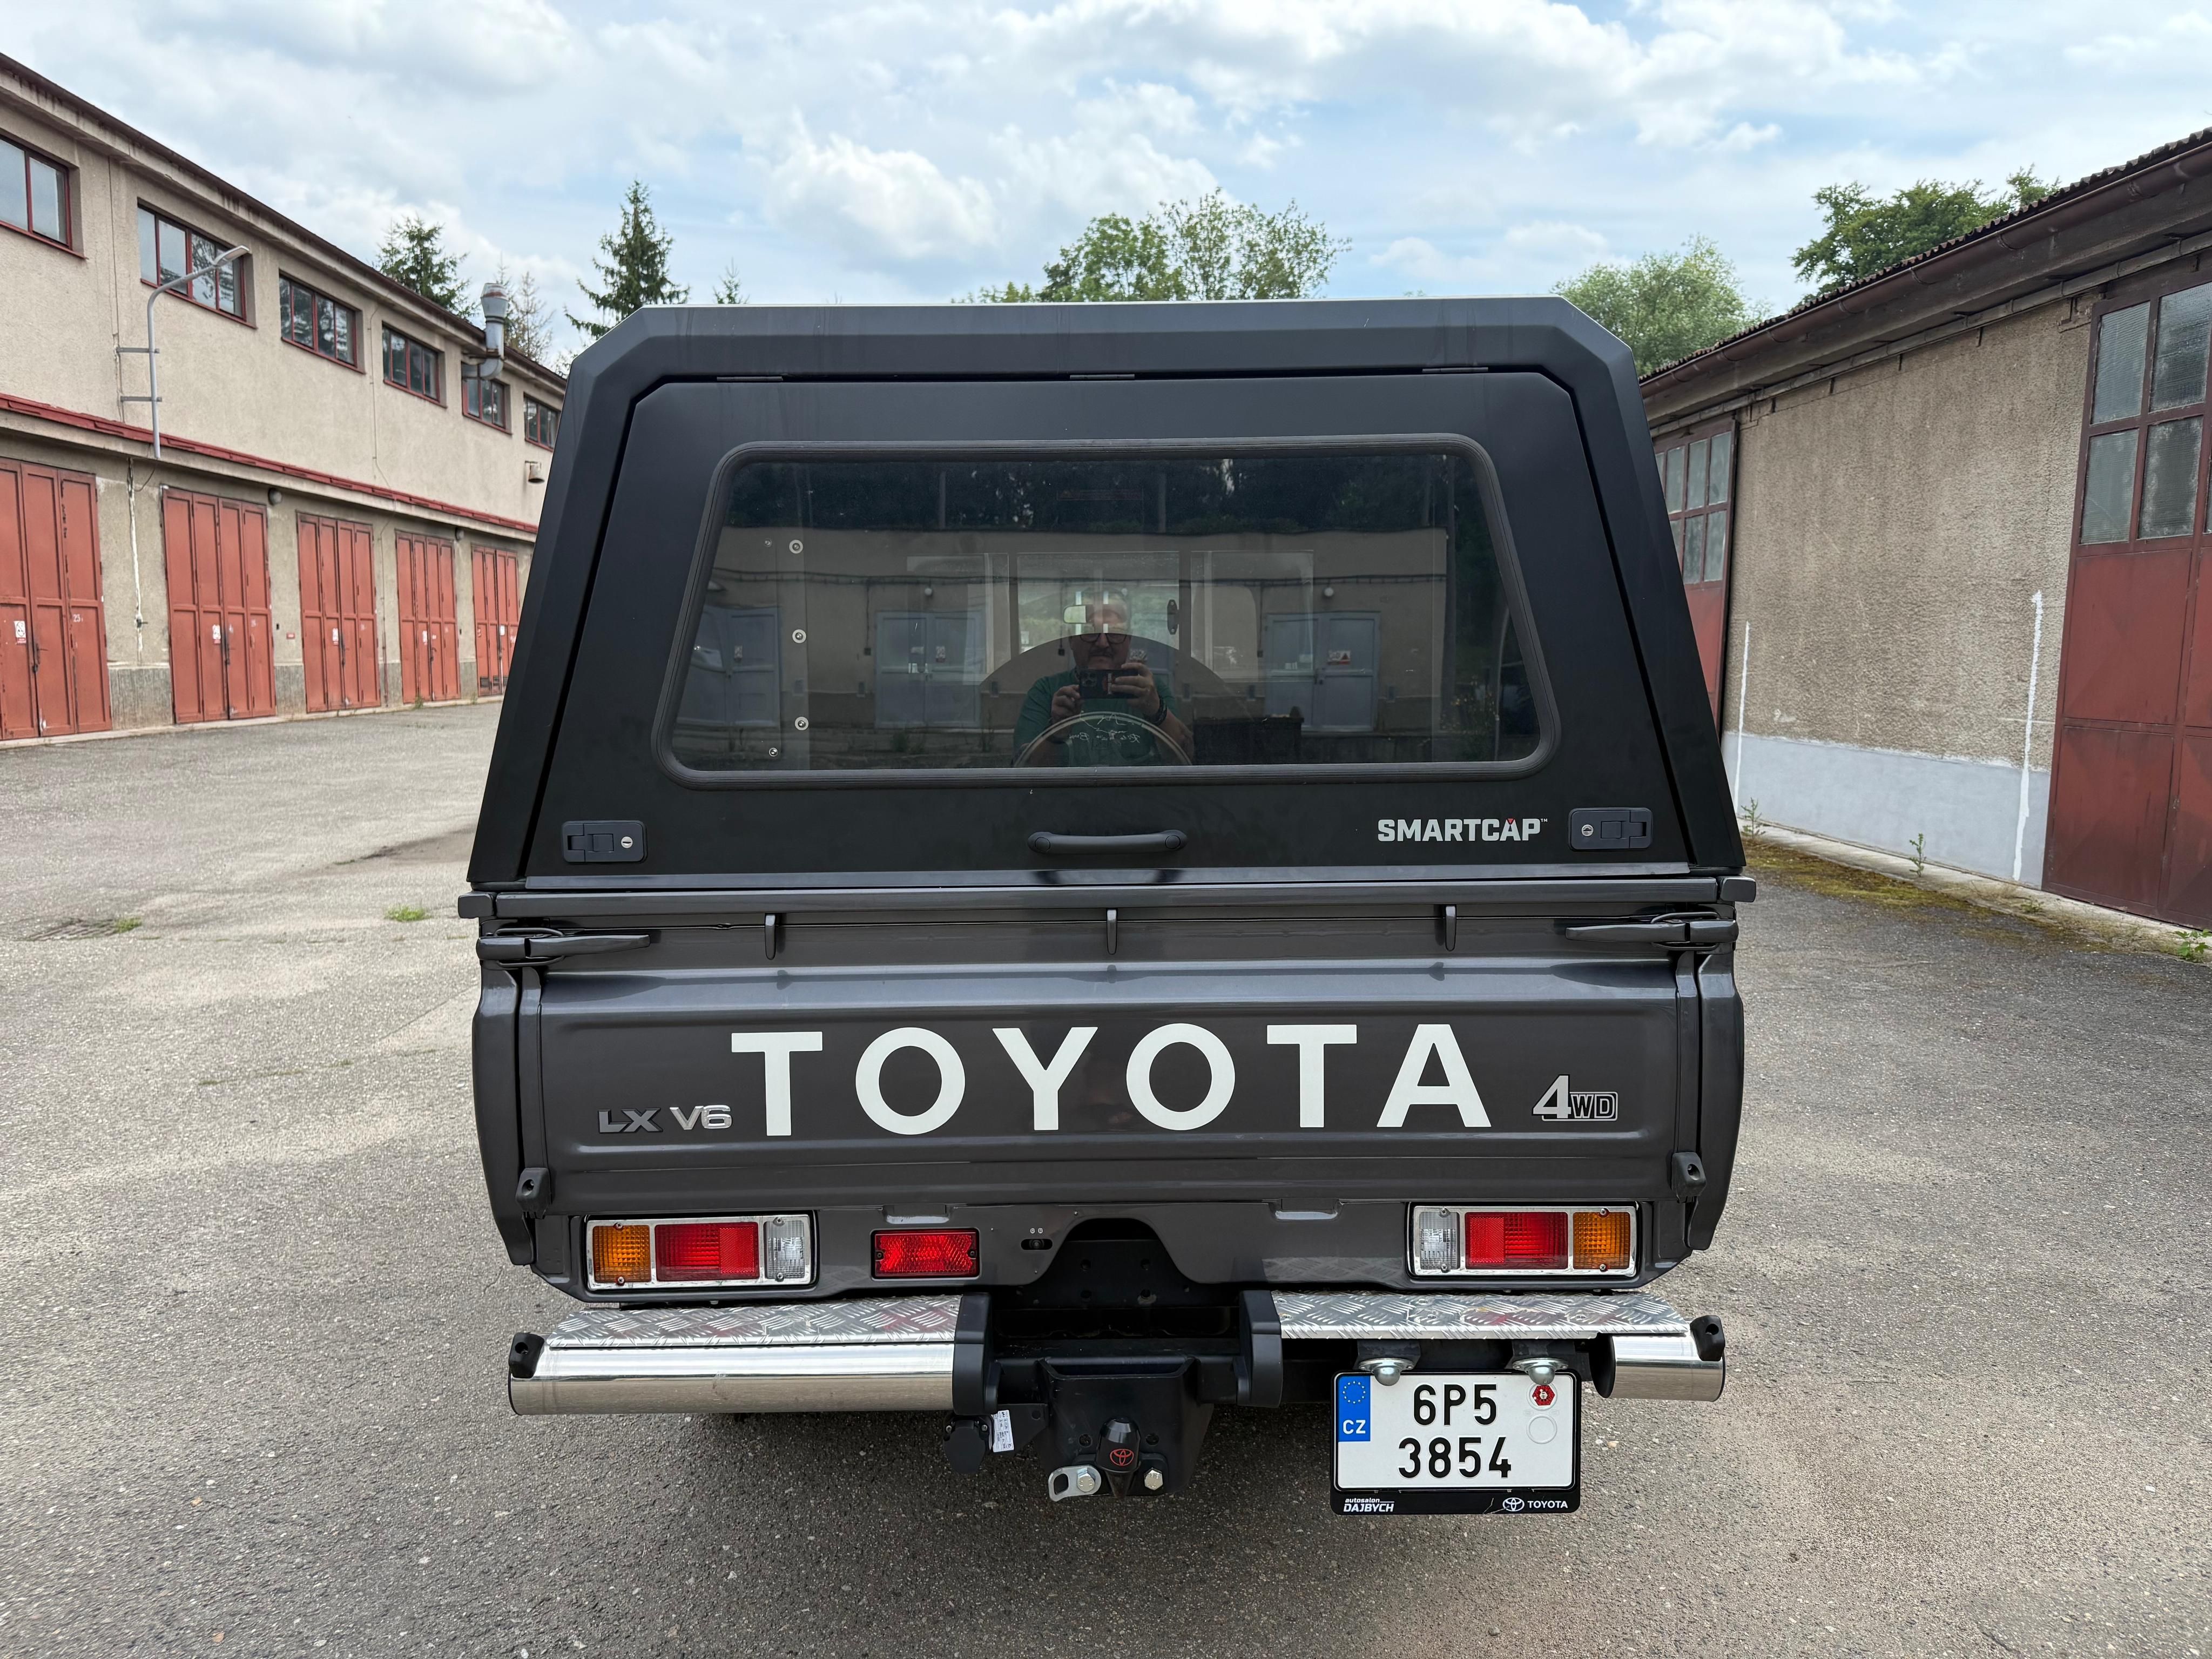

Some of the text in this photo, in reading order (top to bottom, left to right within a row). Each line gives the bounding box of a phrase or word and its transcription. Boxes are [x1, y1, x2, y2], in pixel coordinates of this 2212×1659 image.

[731, 1023, 1492, 1136] TOYOTA
[1533, 1075, 1616, 1119] 4WD
[598, 1104, 732, 1133] LX V6
[1413, 1384, 1498, 1426] 6P5
[1343, 1419, 1366, 1435] CZ
[1398, 1437, 1512, 1479] 3854
[1343, 1503, 1394, 1512] DAJBYCH
[1527, 1500, 1568, 1508] TOYOTA
